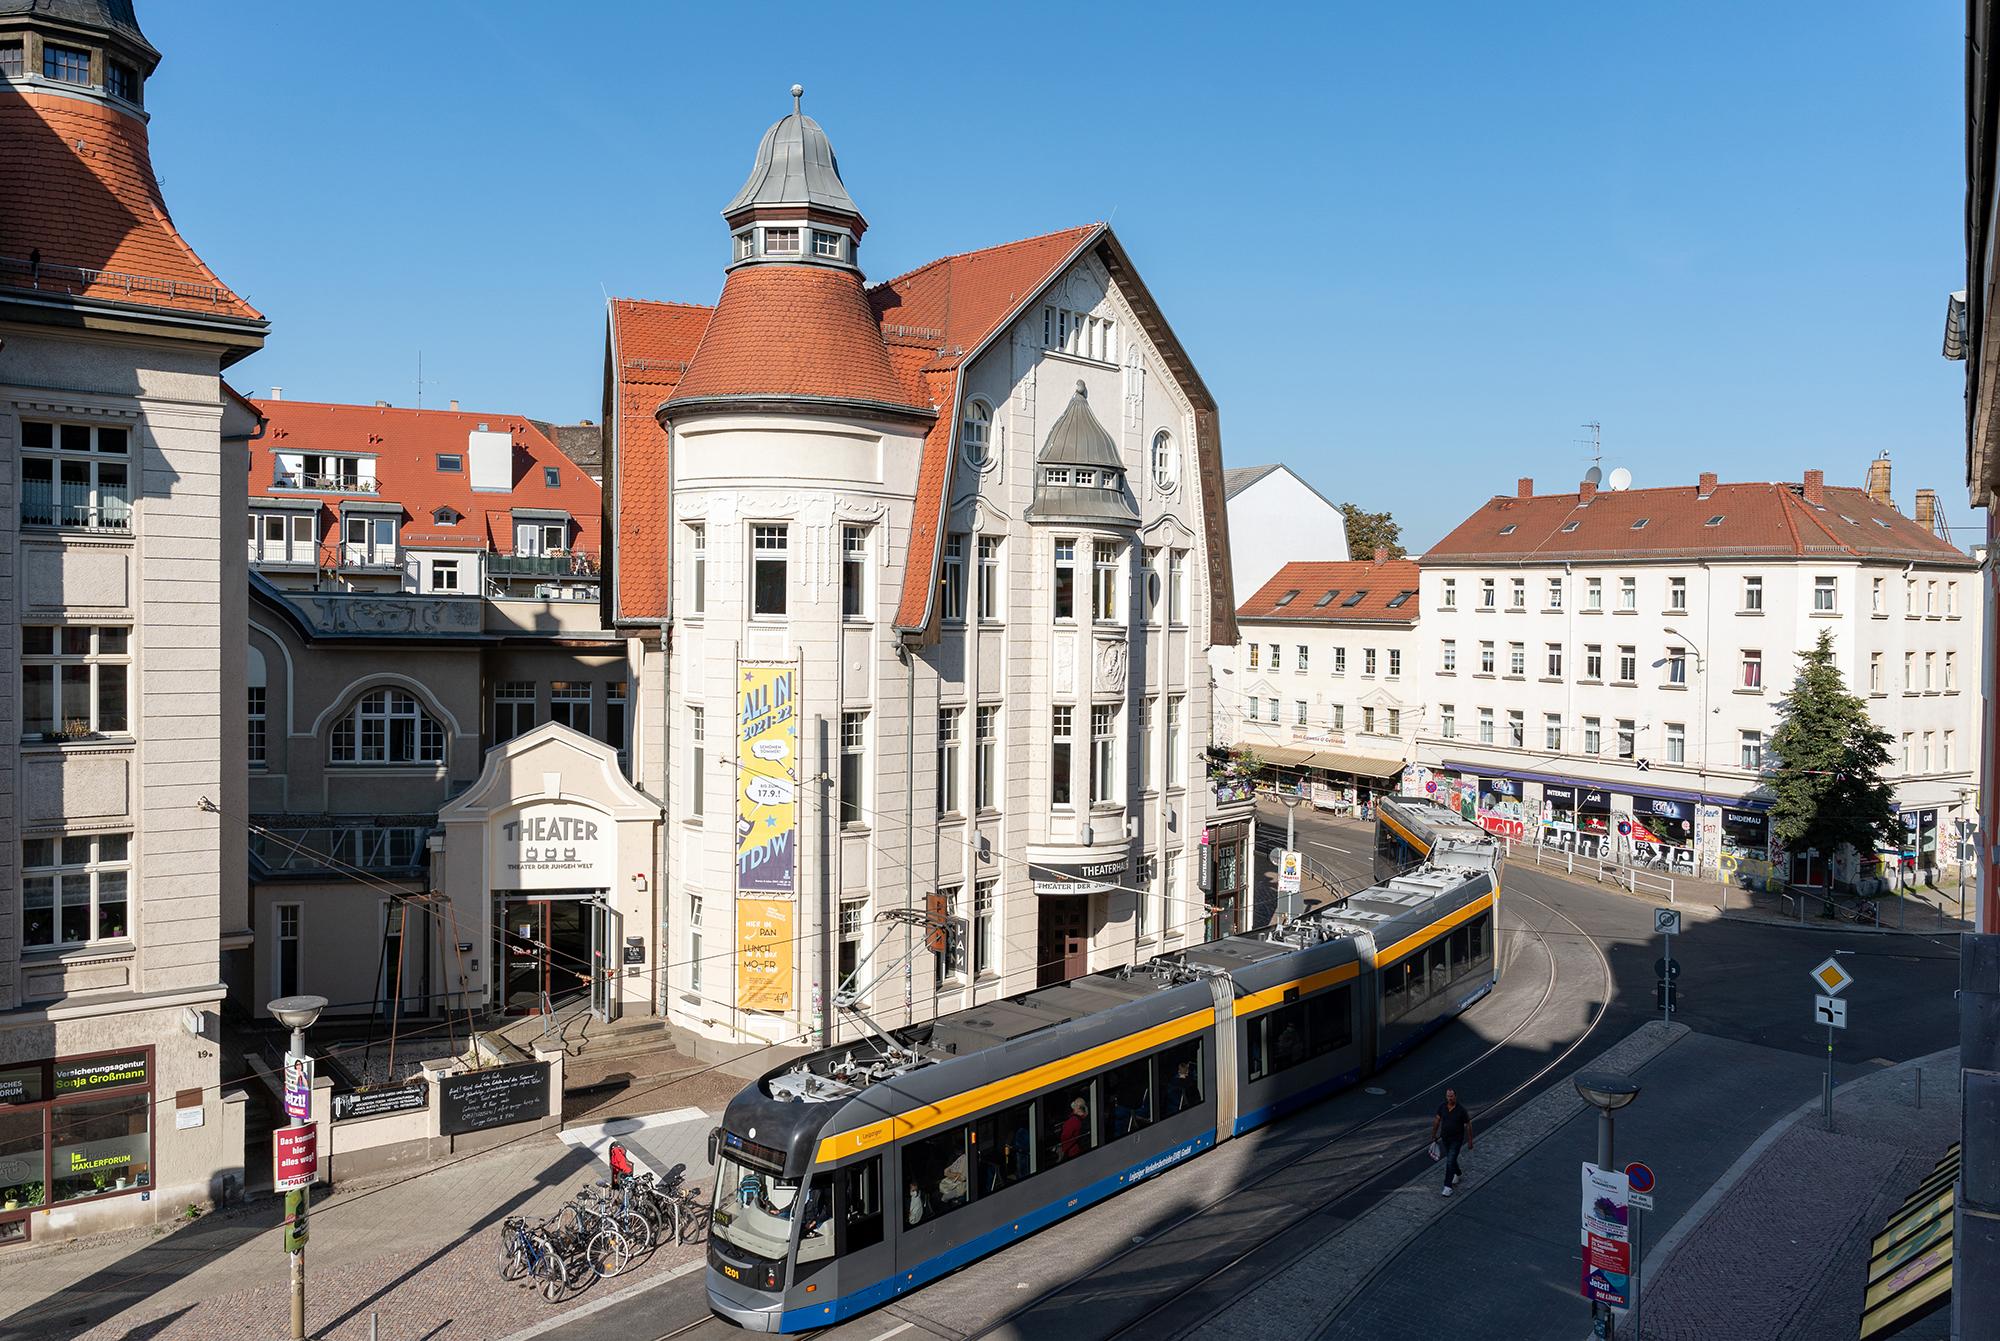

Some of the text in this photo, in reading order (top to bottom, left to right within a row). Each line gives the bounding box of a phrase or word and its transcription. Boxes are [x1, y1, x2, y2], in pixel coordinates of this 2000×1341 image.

[741, 671, 792, 725] ALL IN
[1546, 789, 1571, 798] INTERNET
[1728, 813, 1761, 824] LINDENAU
[503, 816, 599, 841] THEATER
[739, 830, 789, 874] TDJW
[759, 928, 777, 936] PAN
[57, 1060, 145, 1078] Versicherungsagentur
[56, 1069, 145, 1089] Sonja Großmann
[280, 1131, 315, 1146] Das kommt
[292, 1145, 306, 1155] hier
[71, 1154, 131, 1172] MAKLERFORUM
[281, 1151, 315, 1167] alles weg!
[288, 1174, 315, 1186] PARTEI
[724, 1265, 740, 1280] 1201
[1590, 1279, 1610, 1292] Jetzt!
